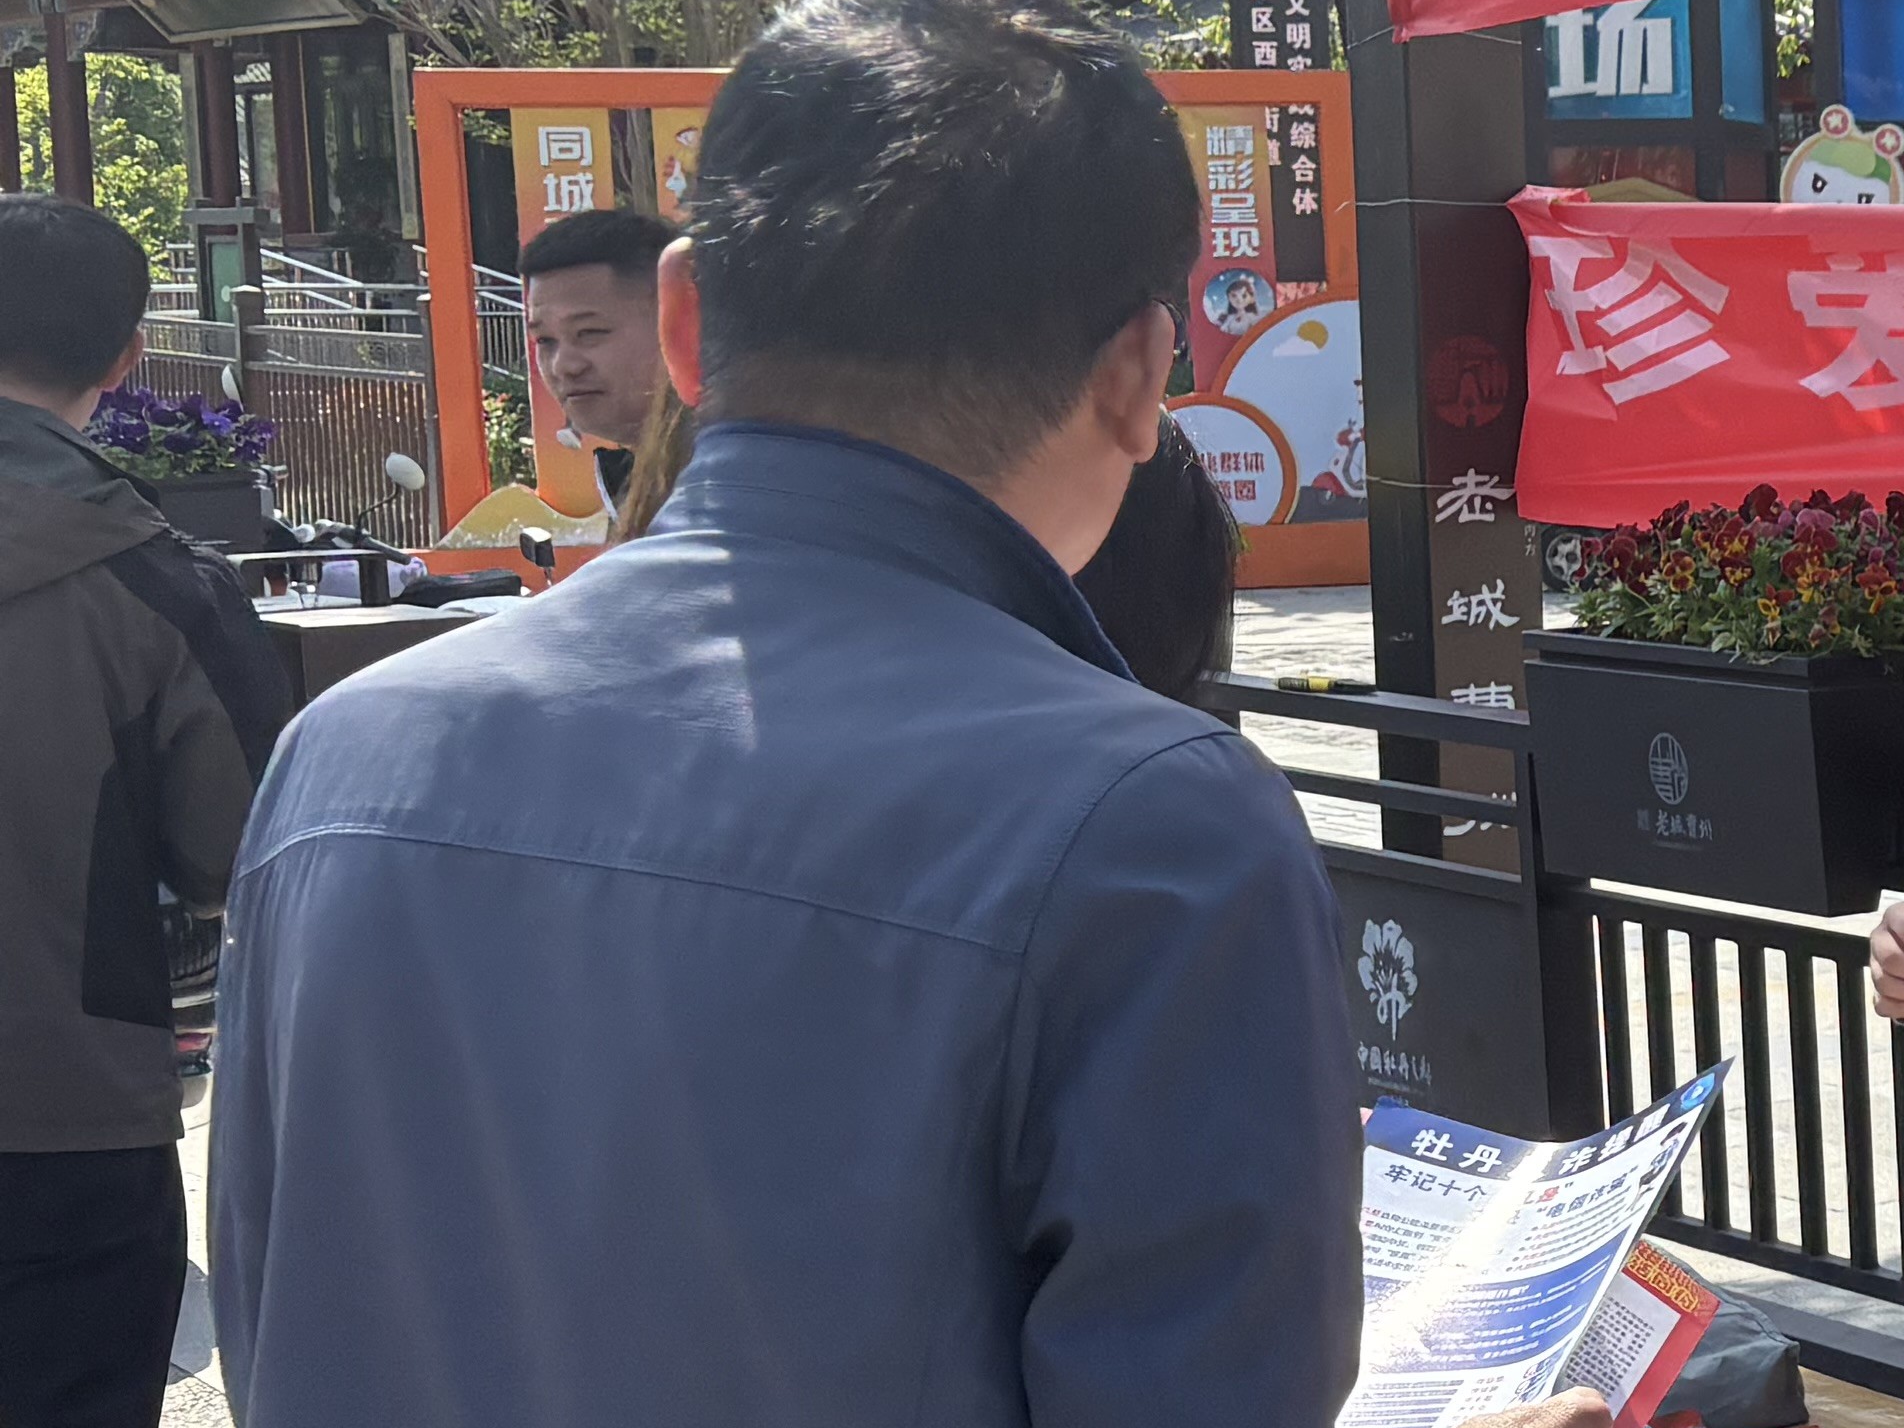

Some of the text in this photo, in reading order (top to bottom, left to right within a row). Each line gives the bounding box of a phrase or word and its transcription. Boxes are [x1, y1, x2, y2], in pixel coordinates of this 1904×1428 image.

[538, 126, 595, 223] 同城
[1207, 125, 1261, 259] 精彩呈现
